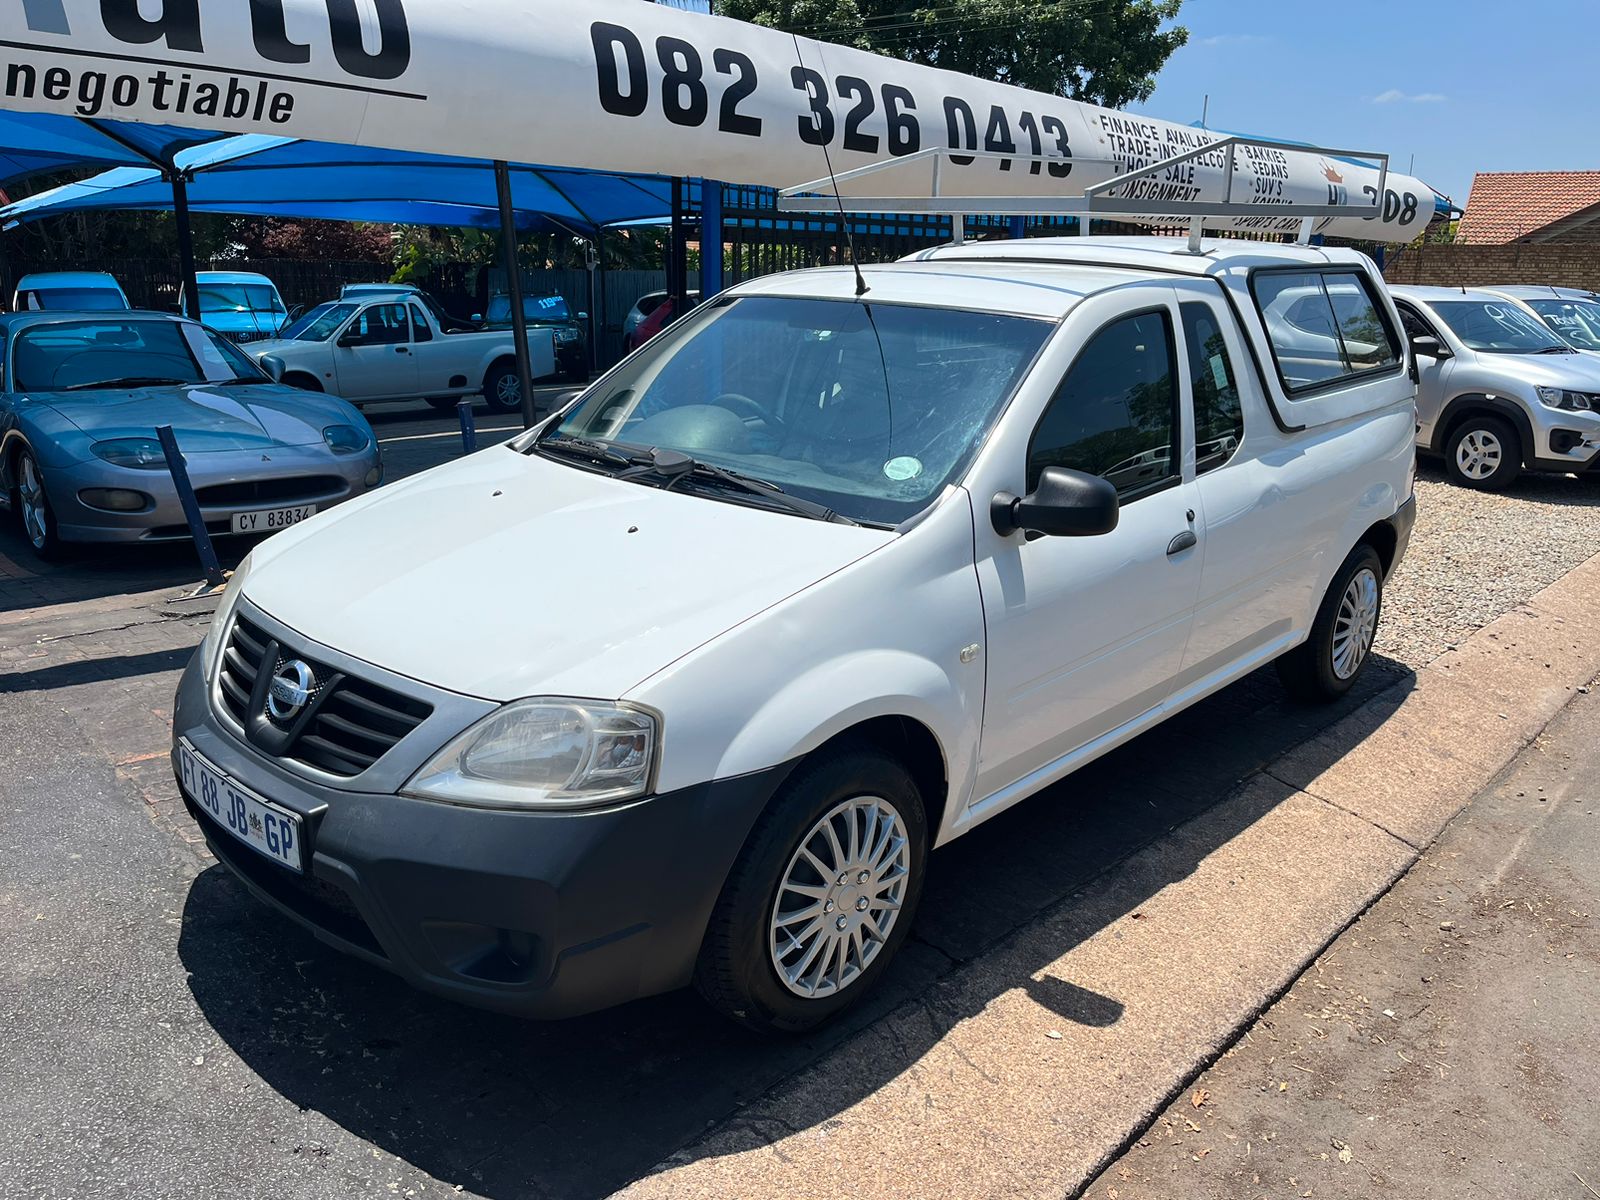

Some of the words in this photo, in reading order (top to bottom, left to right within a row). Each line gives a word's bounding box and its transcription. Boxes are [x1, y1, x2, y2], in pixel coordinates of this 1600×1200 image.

[5, 63, 295, 124] negotiable
[590, 21, 762, 138] 082
[790, 66, 921, 157] 326
[943, 96, 1073, 179] 0413
[1099, 114, 1160, 141] FINANCE
[1166, 128, 1224, 153] AVAILAB
[1107, 133, 1178, 158] TRADE-INS
[1182, 146, 1239, 172] ELCOE
[1244, 145, 1287, 165] BAKKIES
[1165, 164, 1195, 185] SALE
[1252, 161, 1289, 179] SEDANS
[1255, 177, 1283, 196] SUV'S
[240, 514, 257, 529] CY
[268, 508, 309, 527] 83834
[200, 769, 220, 816] 88
[226, 789, 249, 836] JB
[264, 812, 293, 860] GP
